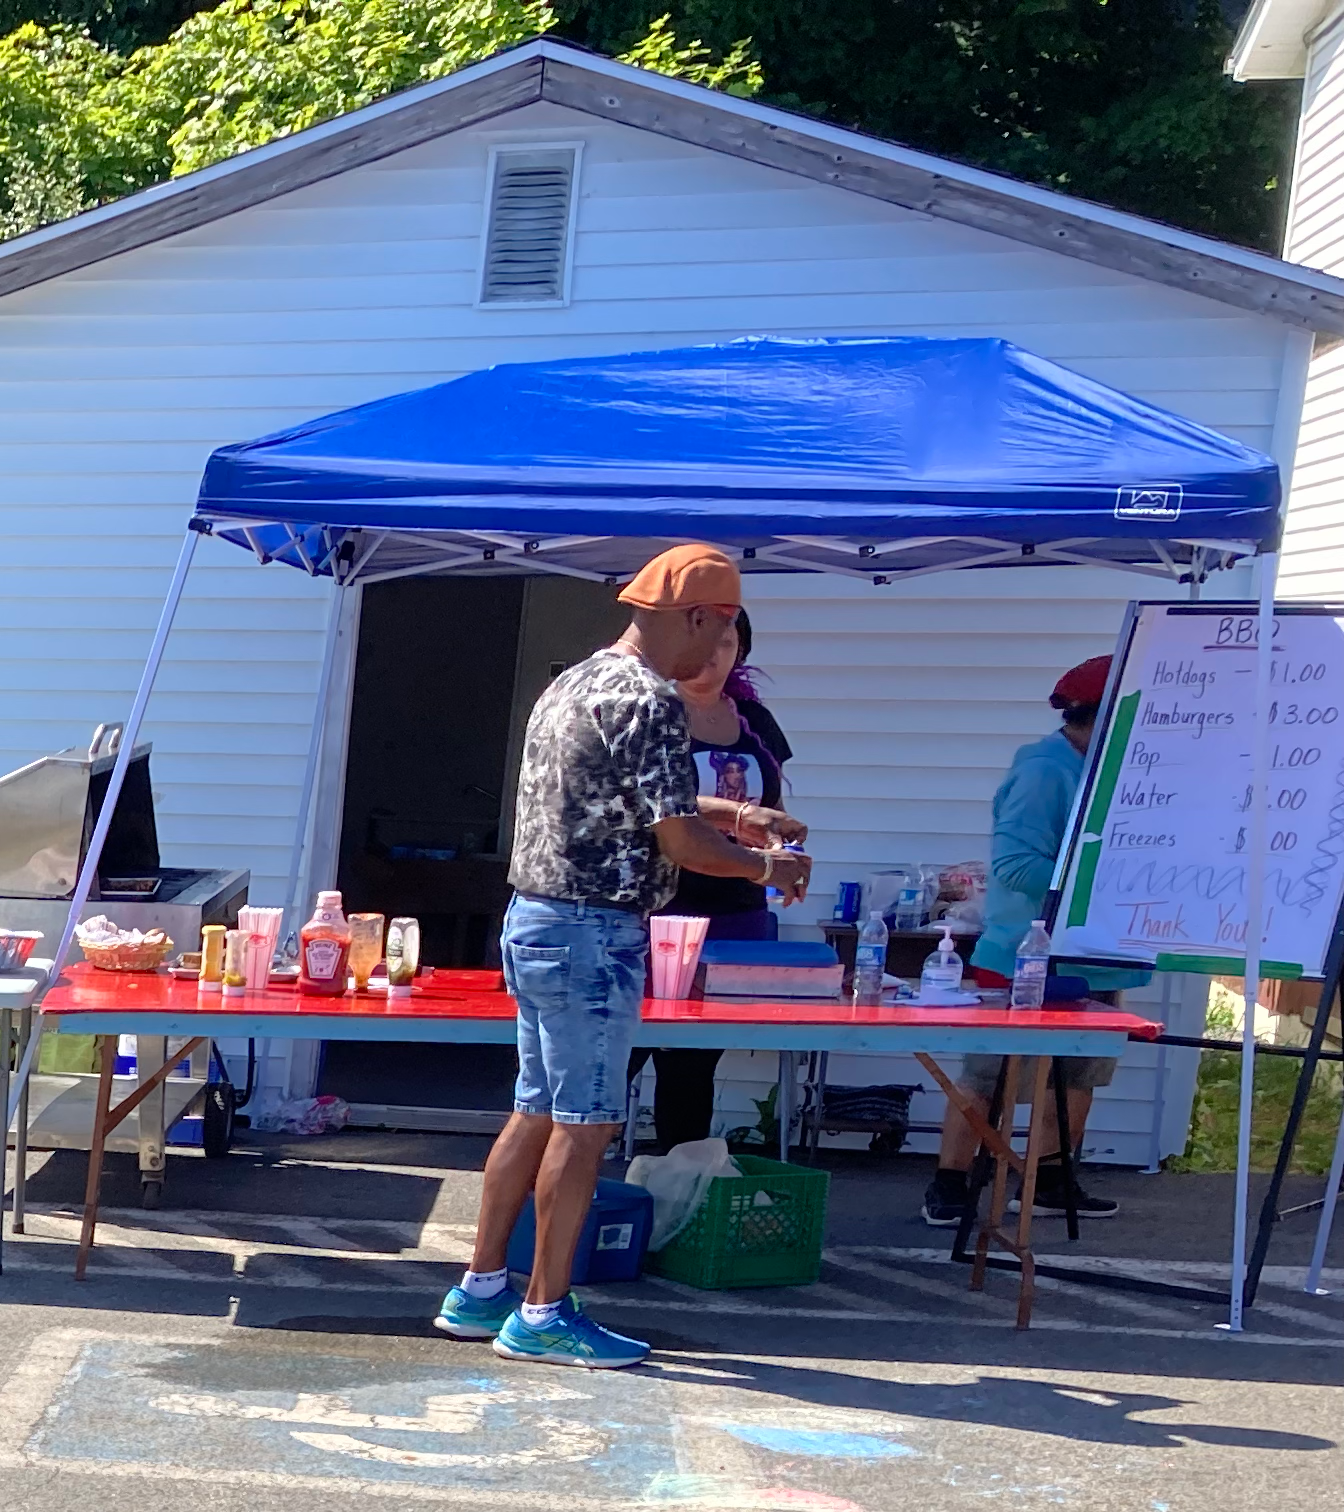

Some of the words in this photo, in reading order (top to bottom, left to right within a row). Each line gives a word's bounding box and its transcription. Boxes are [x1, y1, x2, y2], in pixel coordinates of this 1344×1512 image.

[1153, 660, 1217, 699] Hotdogs
[1140, 700, 1235, 740] Hamburgers
[1129, 741, 1161, 776] Pop
[1120, 781, 1179, 807] Water
[1115, 901, 1190, 940] Thank
